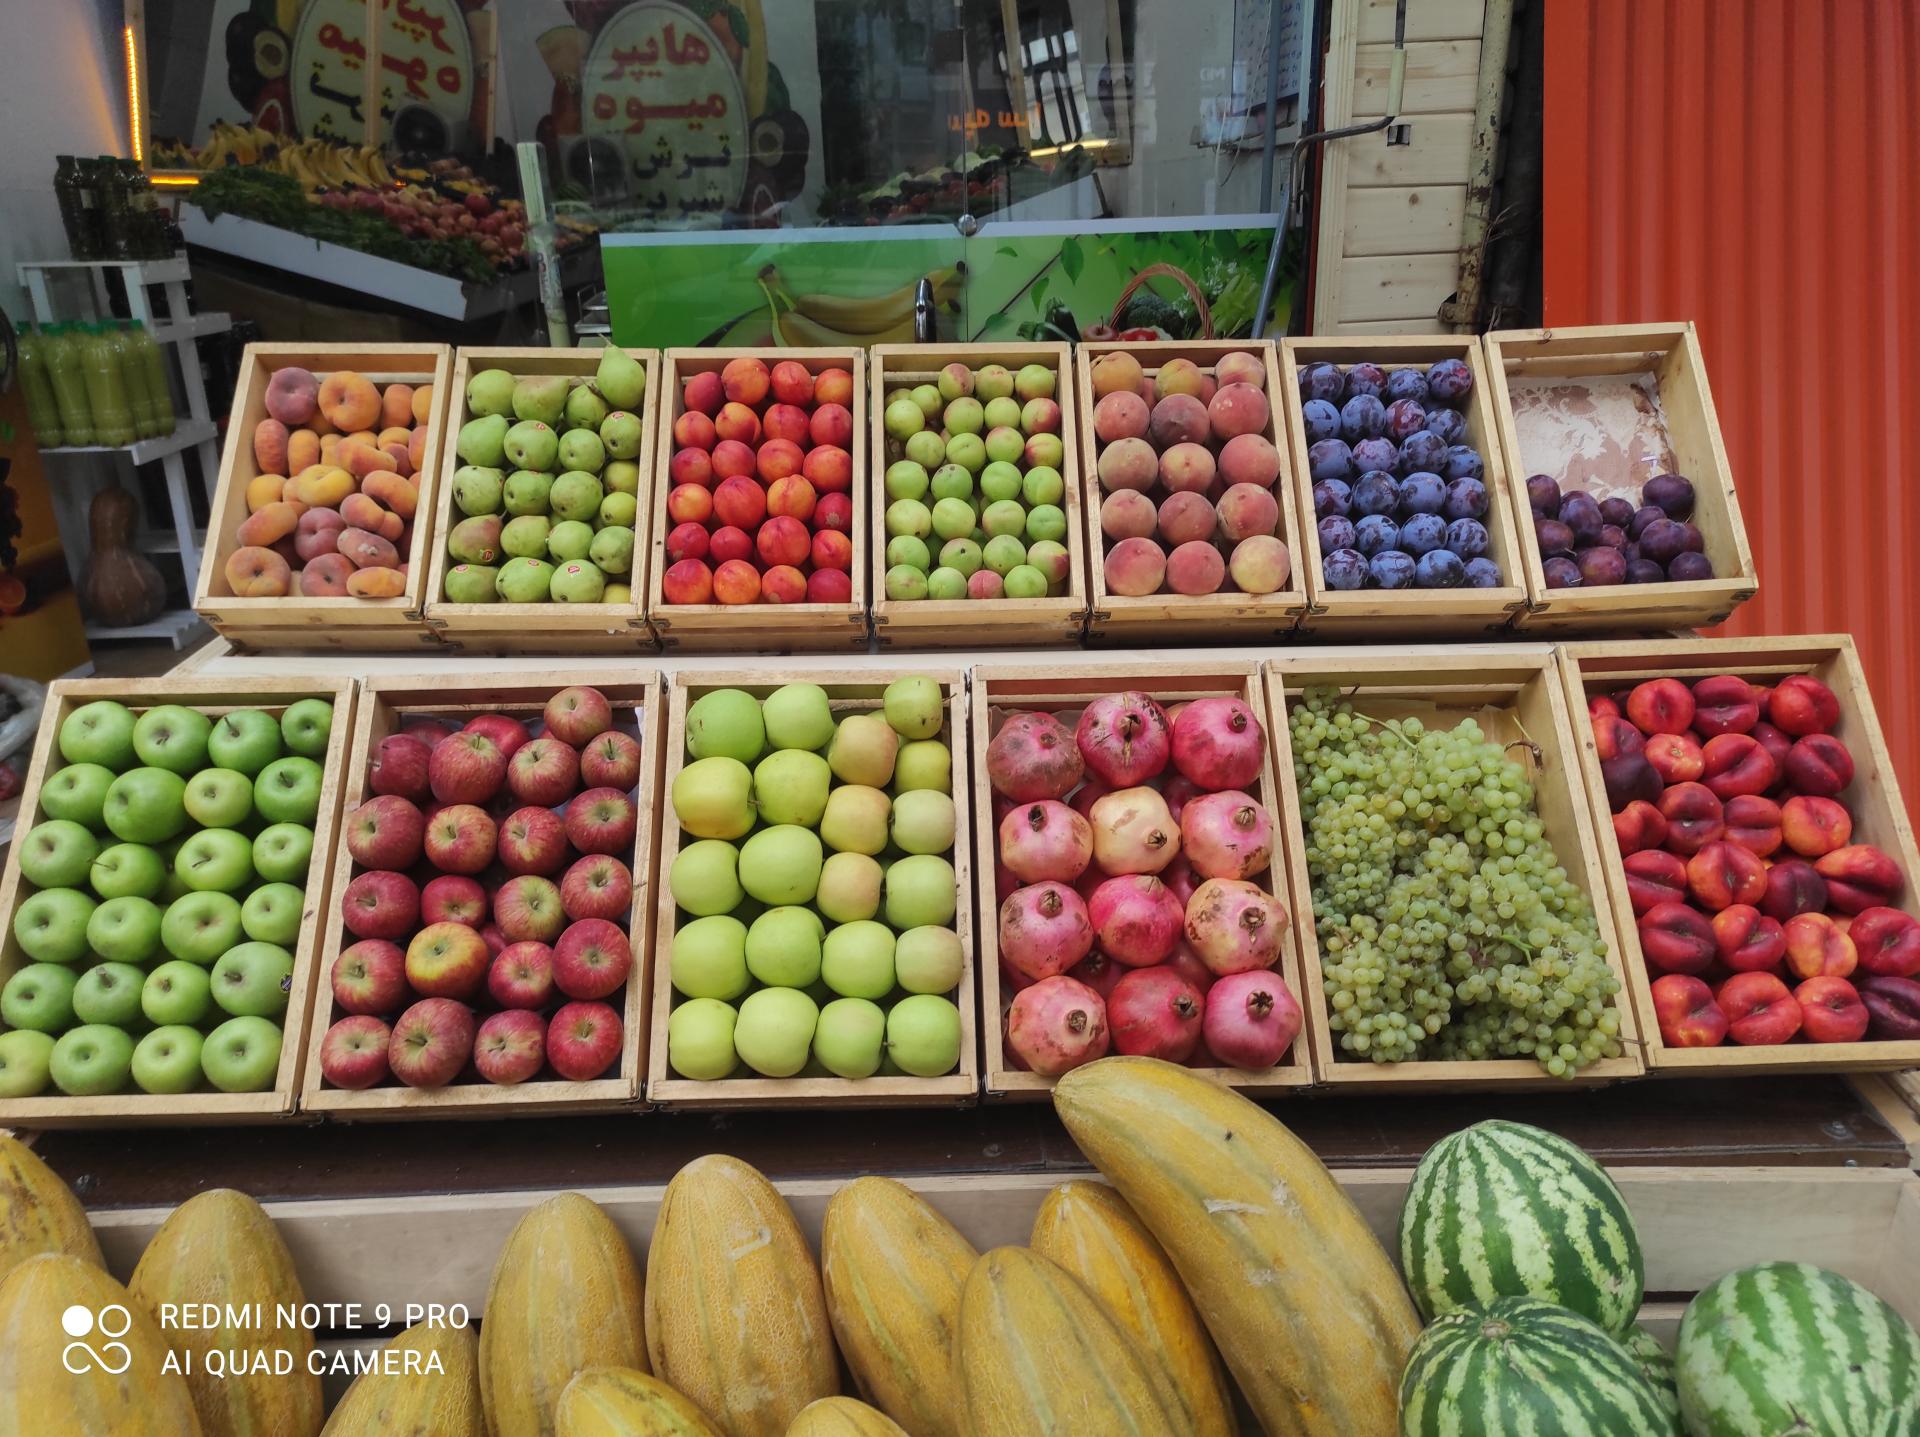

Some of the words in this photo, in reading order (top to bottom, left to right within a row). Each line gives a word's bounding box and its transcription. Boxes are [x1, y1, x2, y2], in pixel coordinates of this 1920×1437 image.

[602, 22, 709, 82] هایپر
[593, 93, 727, 135] میوه
[634, 135, 731, 180] ترش
